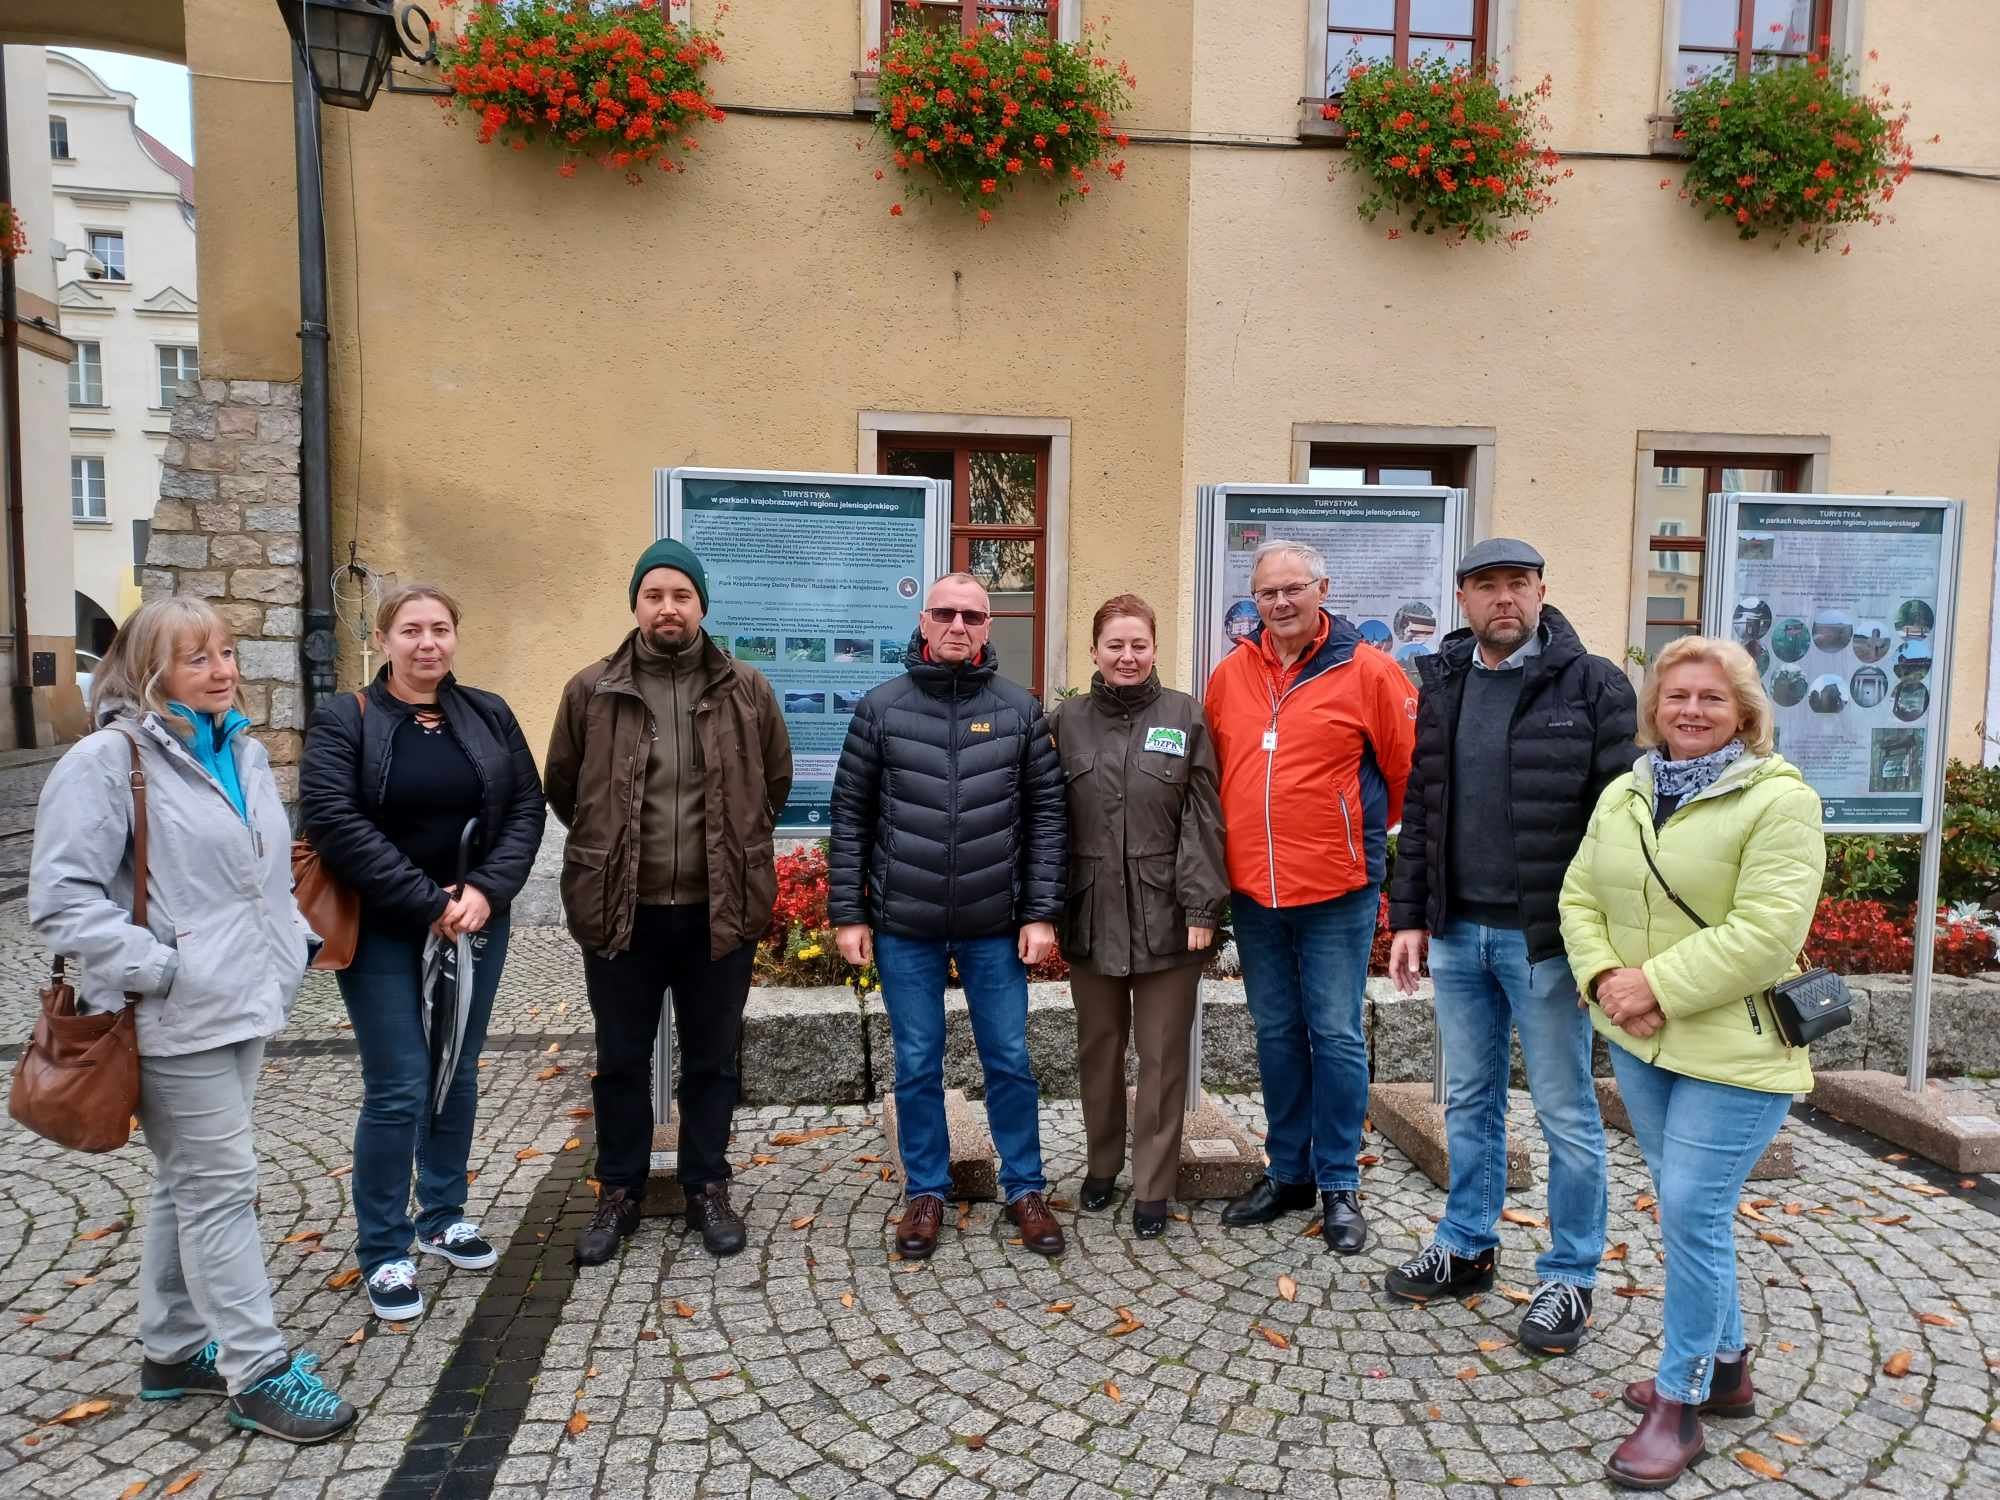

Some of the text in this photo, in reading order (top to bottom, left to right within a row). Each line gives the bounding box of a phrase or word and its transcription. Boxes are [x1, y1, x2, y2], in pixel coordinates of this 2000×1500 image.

[782, 490, 830, 499] TURYSTYKA
[719, 497, 749, 505] parkach
[751, 497, 809, 508] krajobrazowych
[810, 500, 838, 509] regionu
[839, 501, 899, 511] jeleniogórskiego
[1314, 499, 1359, 507] TURYSTYKA
[1257, 506, 1285, 515] parkach
[1286, 507, 1338, 516] krajobrazowych
[1820, 510, 1862, 518] TURYSTYKA
[1766, 517, 1792, 525] parkach
